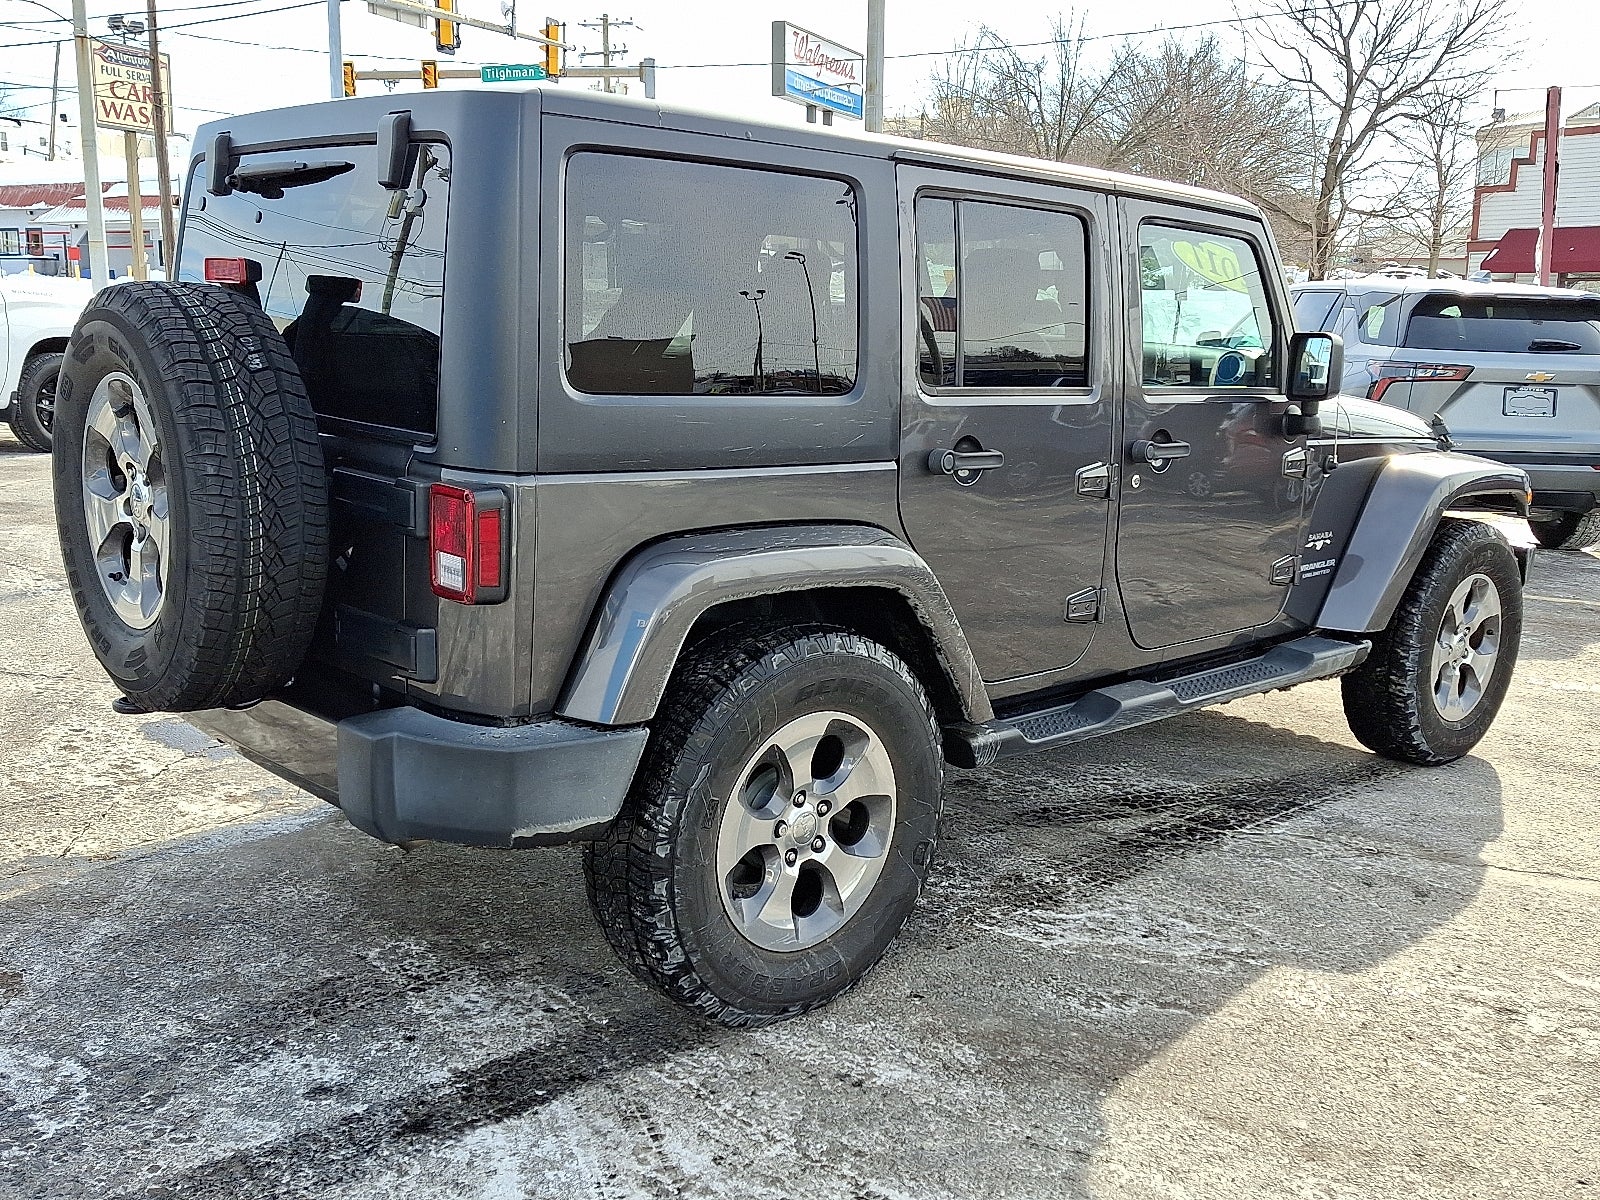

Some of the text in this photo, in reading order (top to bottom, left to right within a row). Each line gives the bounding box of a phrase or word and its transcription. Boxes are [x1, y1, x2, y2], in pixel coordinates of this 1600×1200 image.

[105, 48, 150, 67] Allentow
[792, 31, 856, 81] Walgreens
[100, 64, 152, 83] FULL SERVI
[485, 67, 546, 80] Tilghman S
[109, 79, 154, 105] CAR
[100, 99, 153, 125] WAS
[1300, 558, 1336, 572] WRANGLER
